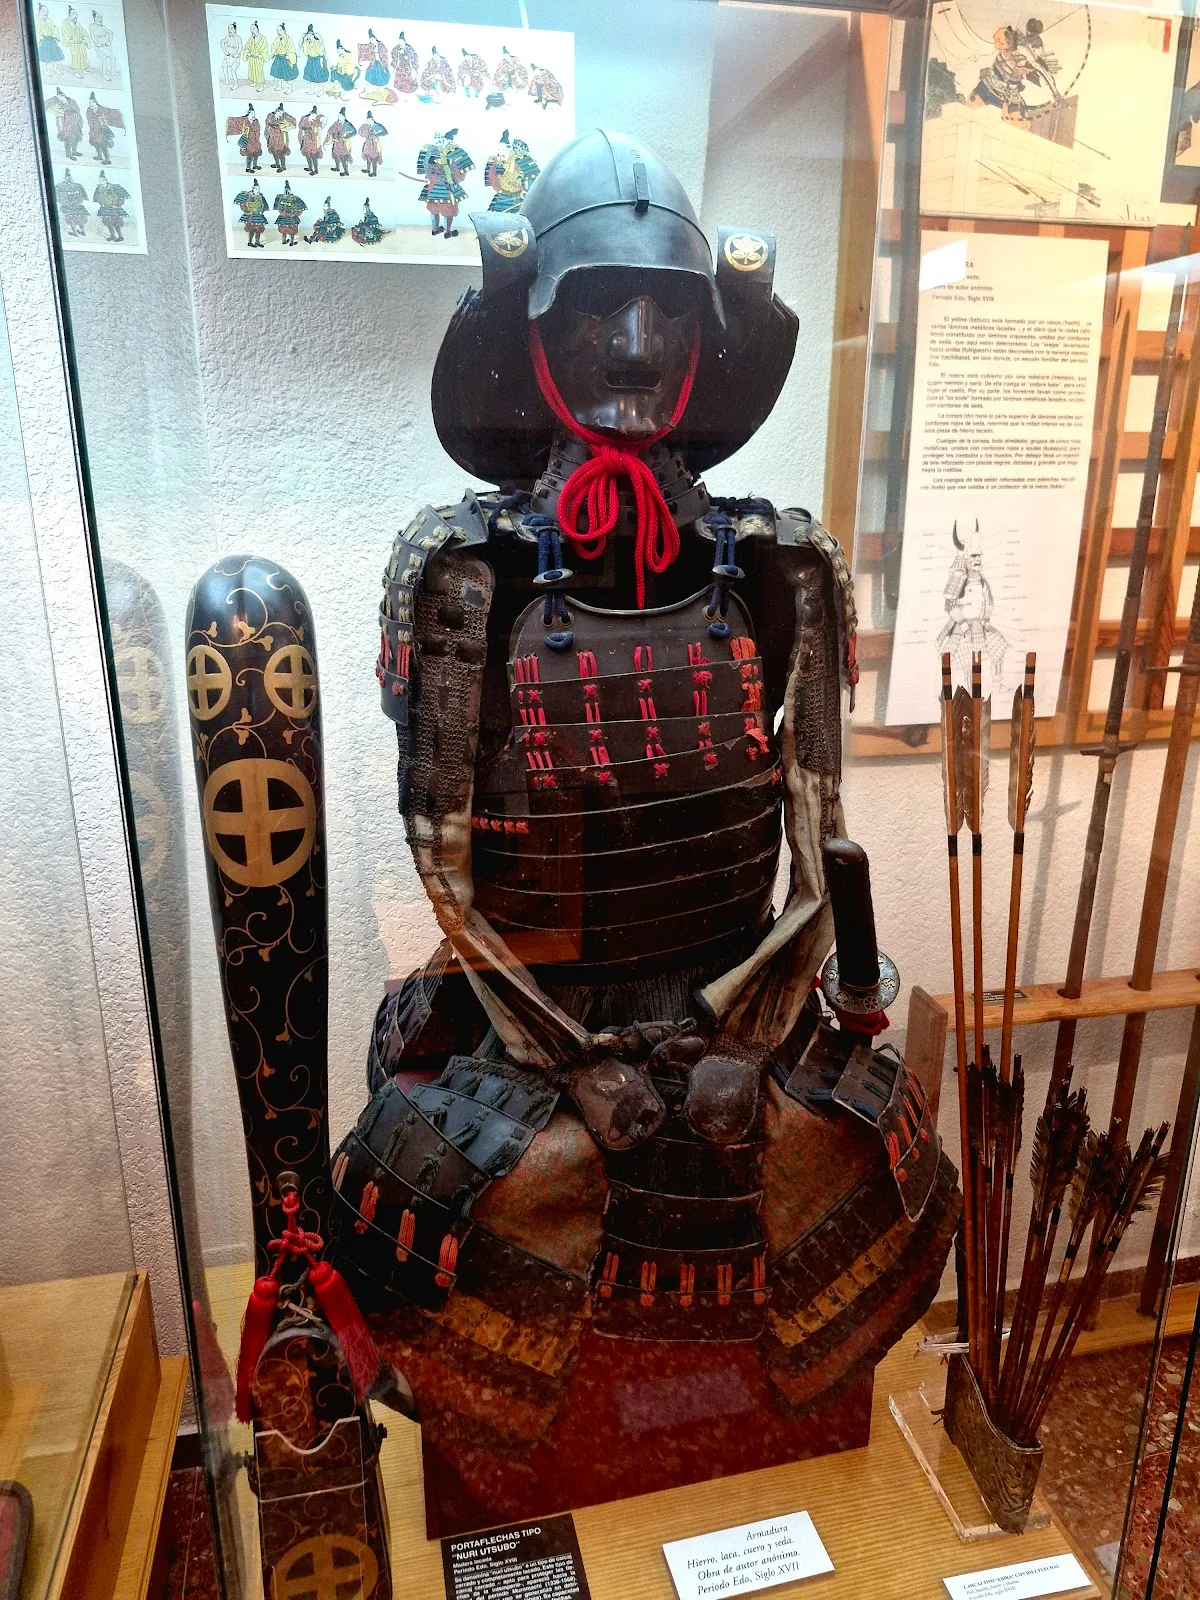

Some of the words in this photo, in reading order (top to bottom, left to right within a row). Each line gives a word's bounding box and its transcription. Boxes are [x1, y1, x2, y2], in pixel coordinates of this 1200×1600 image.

[451, 1532, 520, 1551] PORTAFLECHAS
[522, 1527, 541, 1536] TIPO
[746, 1525, 788, 1540] Armadura
[452, 1550, 478, 1560] “NURI
[480, 1541, 519, 1555] UTSUBO”
[687, 1557, 718, 1569] Hierro,
[720, 1551, 741, 1560] laca,
[743, 1545, 765, 1555] cuero
[767, 1543, 772, 1551] y
[774, 1536, 795, 1547] seda.
[698, 1569, 720, 1580] Obra
[723, 1564, 732, 1574] de
[736, 1560, 758, 1571] autor
[761, 1551, 800, 1564] anónimo.
[698, 1580, 730, 1595] Periodo
[733, 1574, 753, 1586] Edo,
[754, 1568, 775, 1581] Siglo
[778, 1562, 799, 1574] XVII
